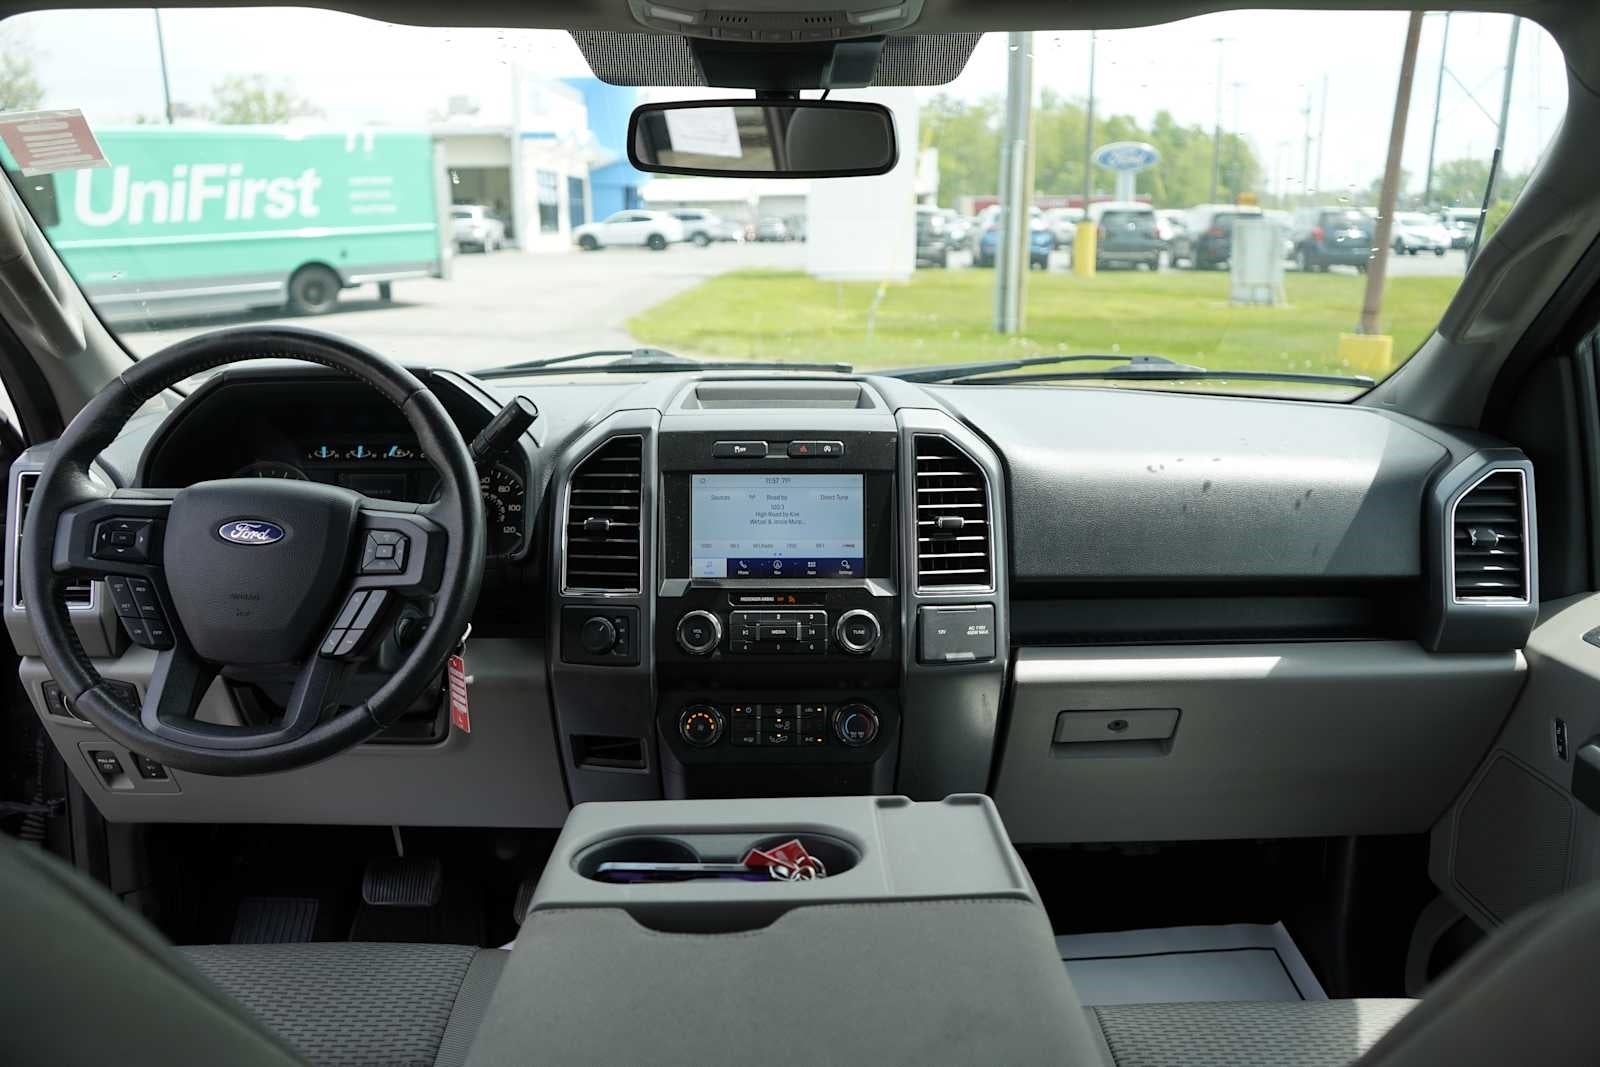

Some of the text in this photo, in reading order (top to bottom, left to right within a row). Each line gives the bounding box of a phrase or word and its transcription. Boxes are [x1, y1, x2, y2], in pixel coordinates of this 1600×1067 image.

[74, 163, 322, 227] UniFirst
[498, 485, 510, 493] 80
[229, 522, 272, 541] Ford
[503, 526, 516, 534] 120
